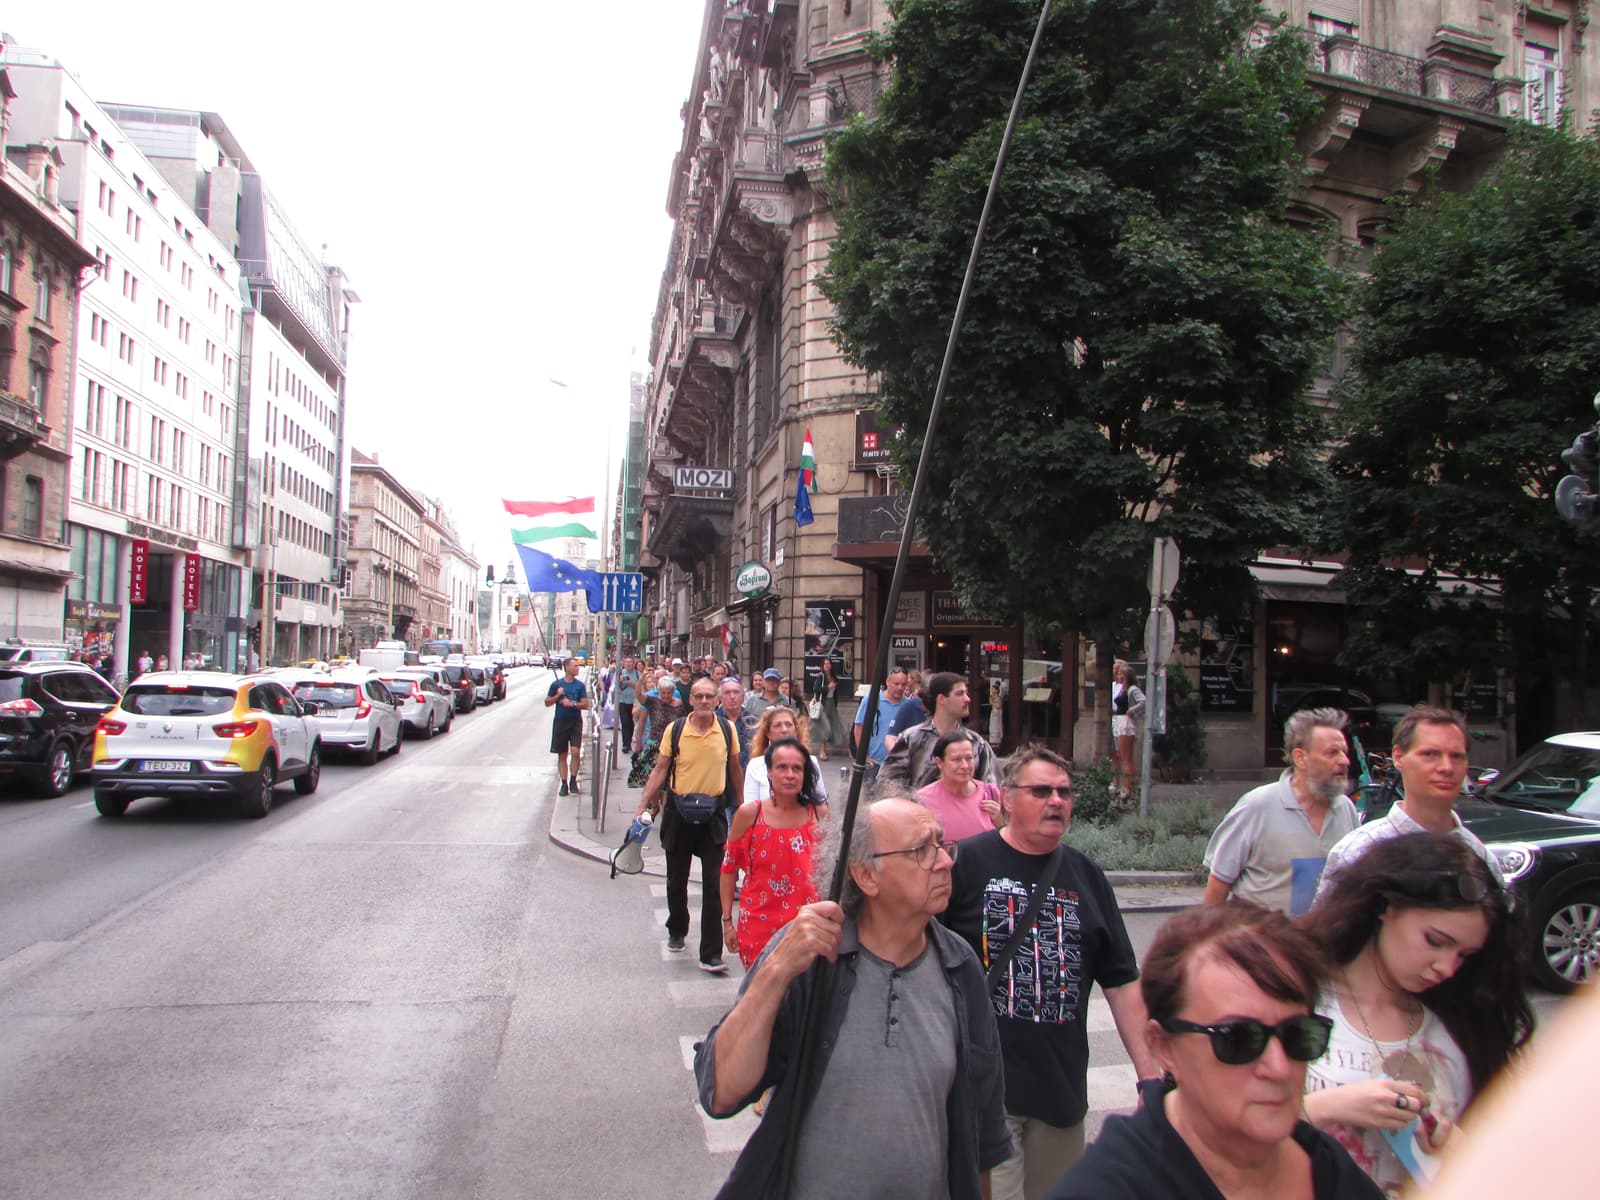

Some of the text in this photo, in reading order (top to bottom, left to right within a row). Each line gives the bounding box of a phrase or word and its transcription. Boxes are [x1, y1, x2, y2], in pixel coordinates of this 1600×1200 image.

[680, 468, 729, 488] MOZI
[136, 546, 144, 590] HOTEL
[188, 559, 196, 588] HOTEL
[739, 573, 768, 587] Soproni
[895, 638, 915, 648] ATM
[984, 644, 1009, 652] OPEN
[147, 761, 189, 771] TEU-324
